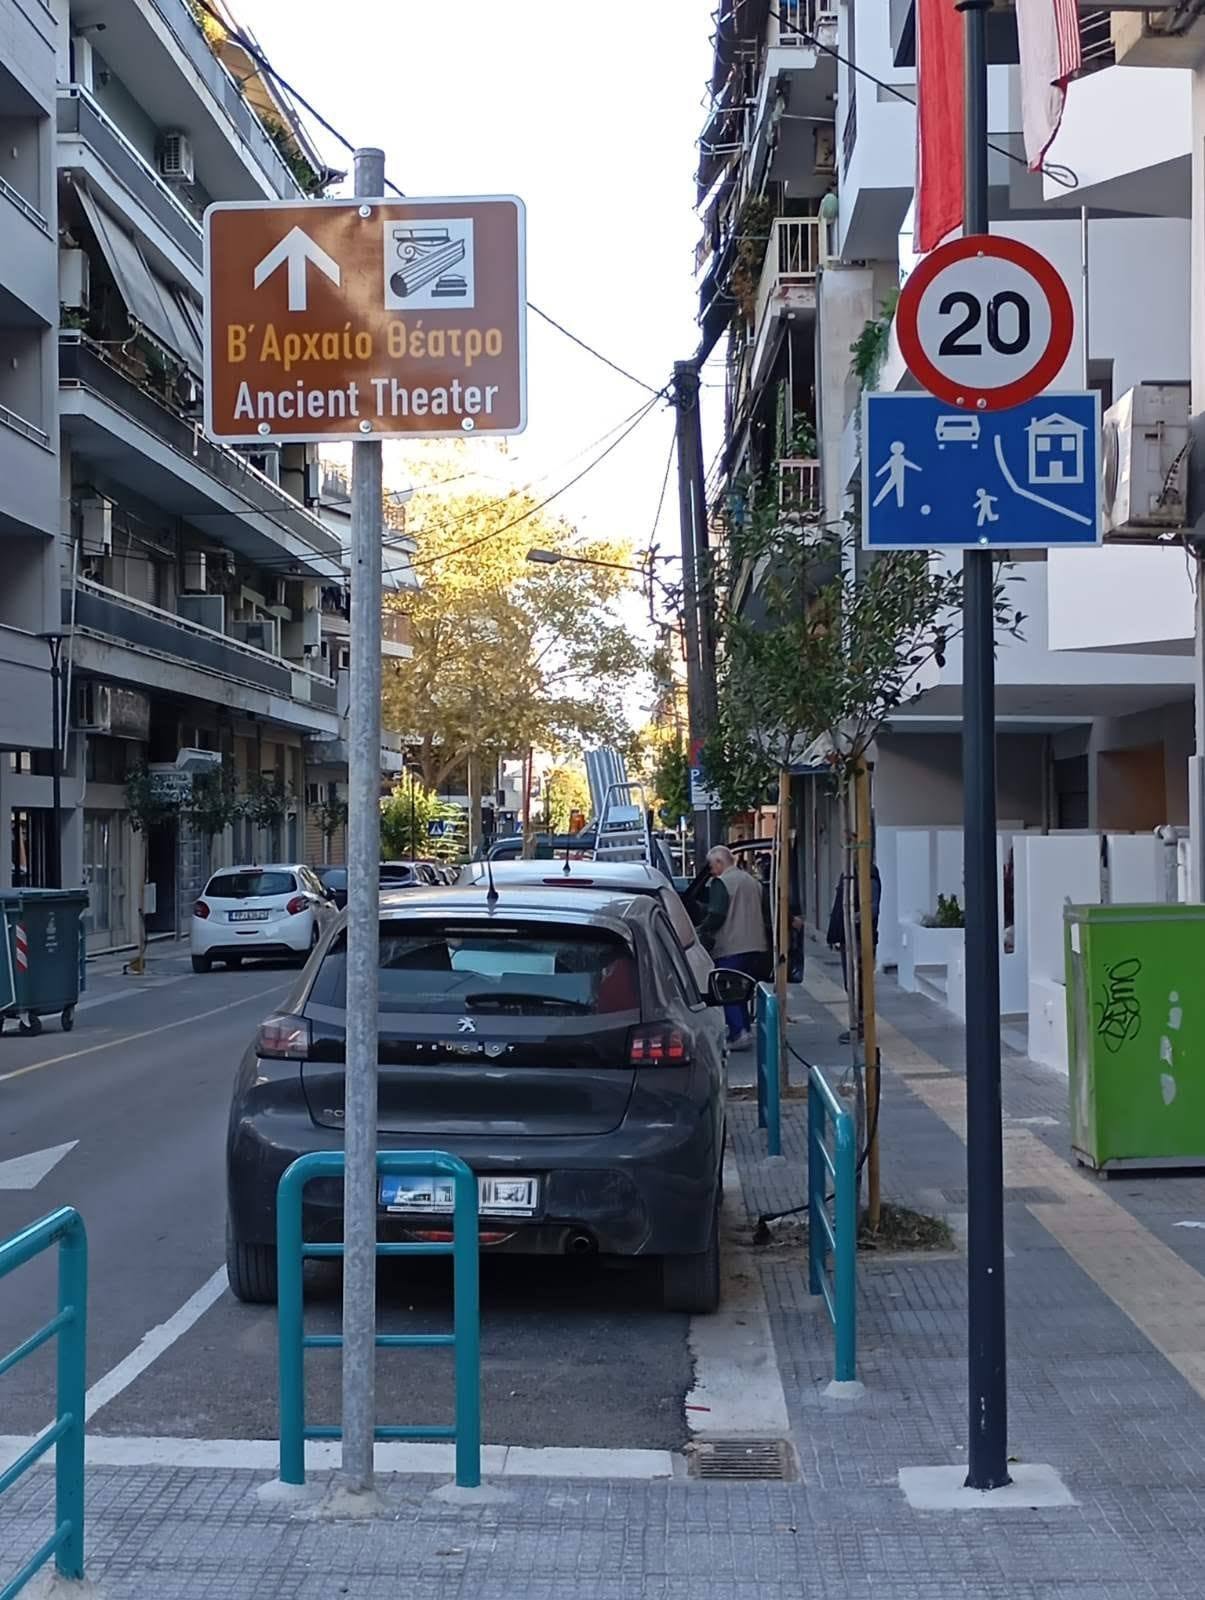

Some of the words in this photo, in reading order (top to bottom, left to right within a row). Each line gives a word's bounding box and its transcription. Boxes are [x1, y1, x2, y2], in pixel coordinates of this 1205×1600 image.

[260, 322, 373, 371] Αρχαίο
[386, 320, 503, 367] Θέατρο
[938, 290, 1030, 356] 20
[233, 380, 360, 420] Ancient
[370, 378, 499, 417] Theater
